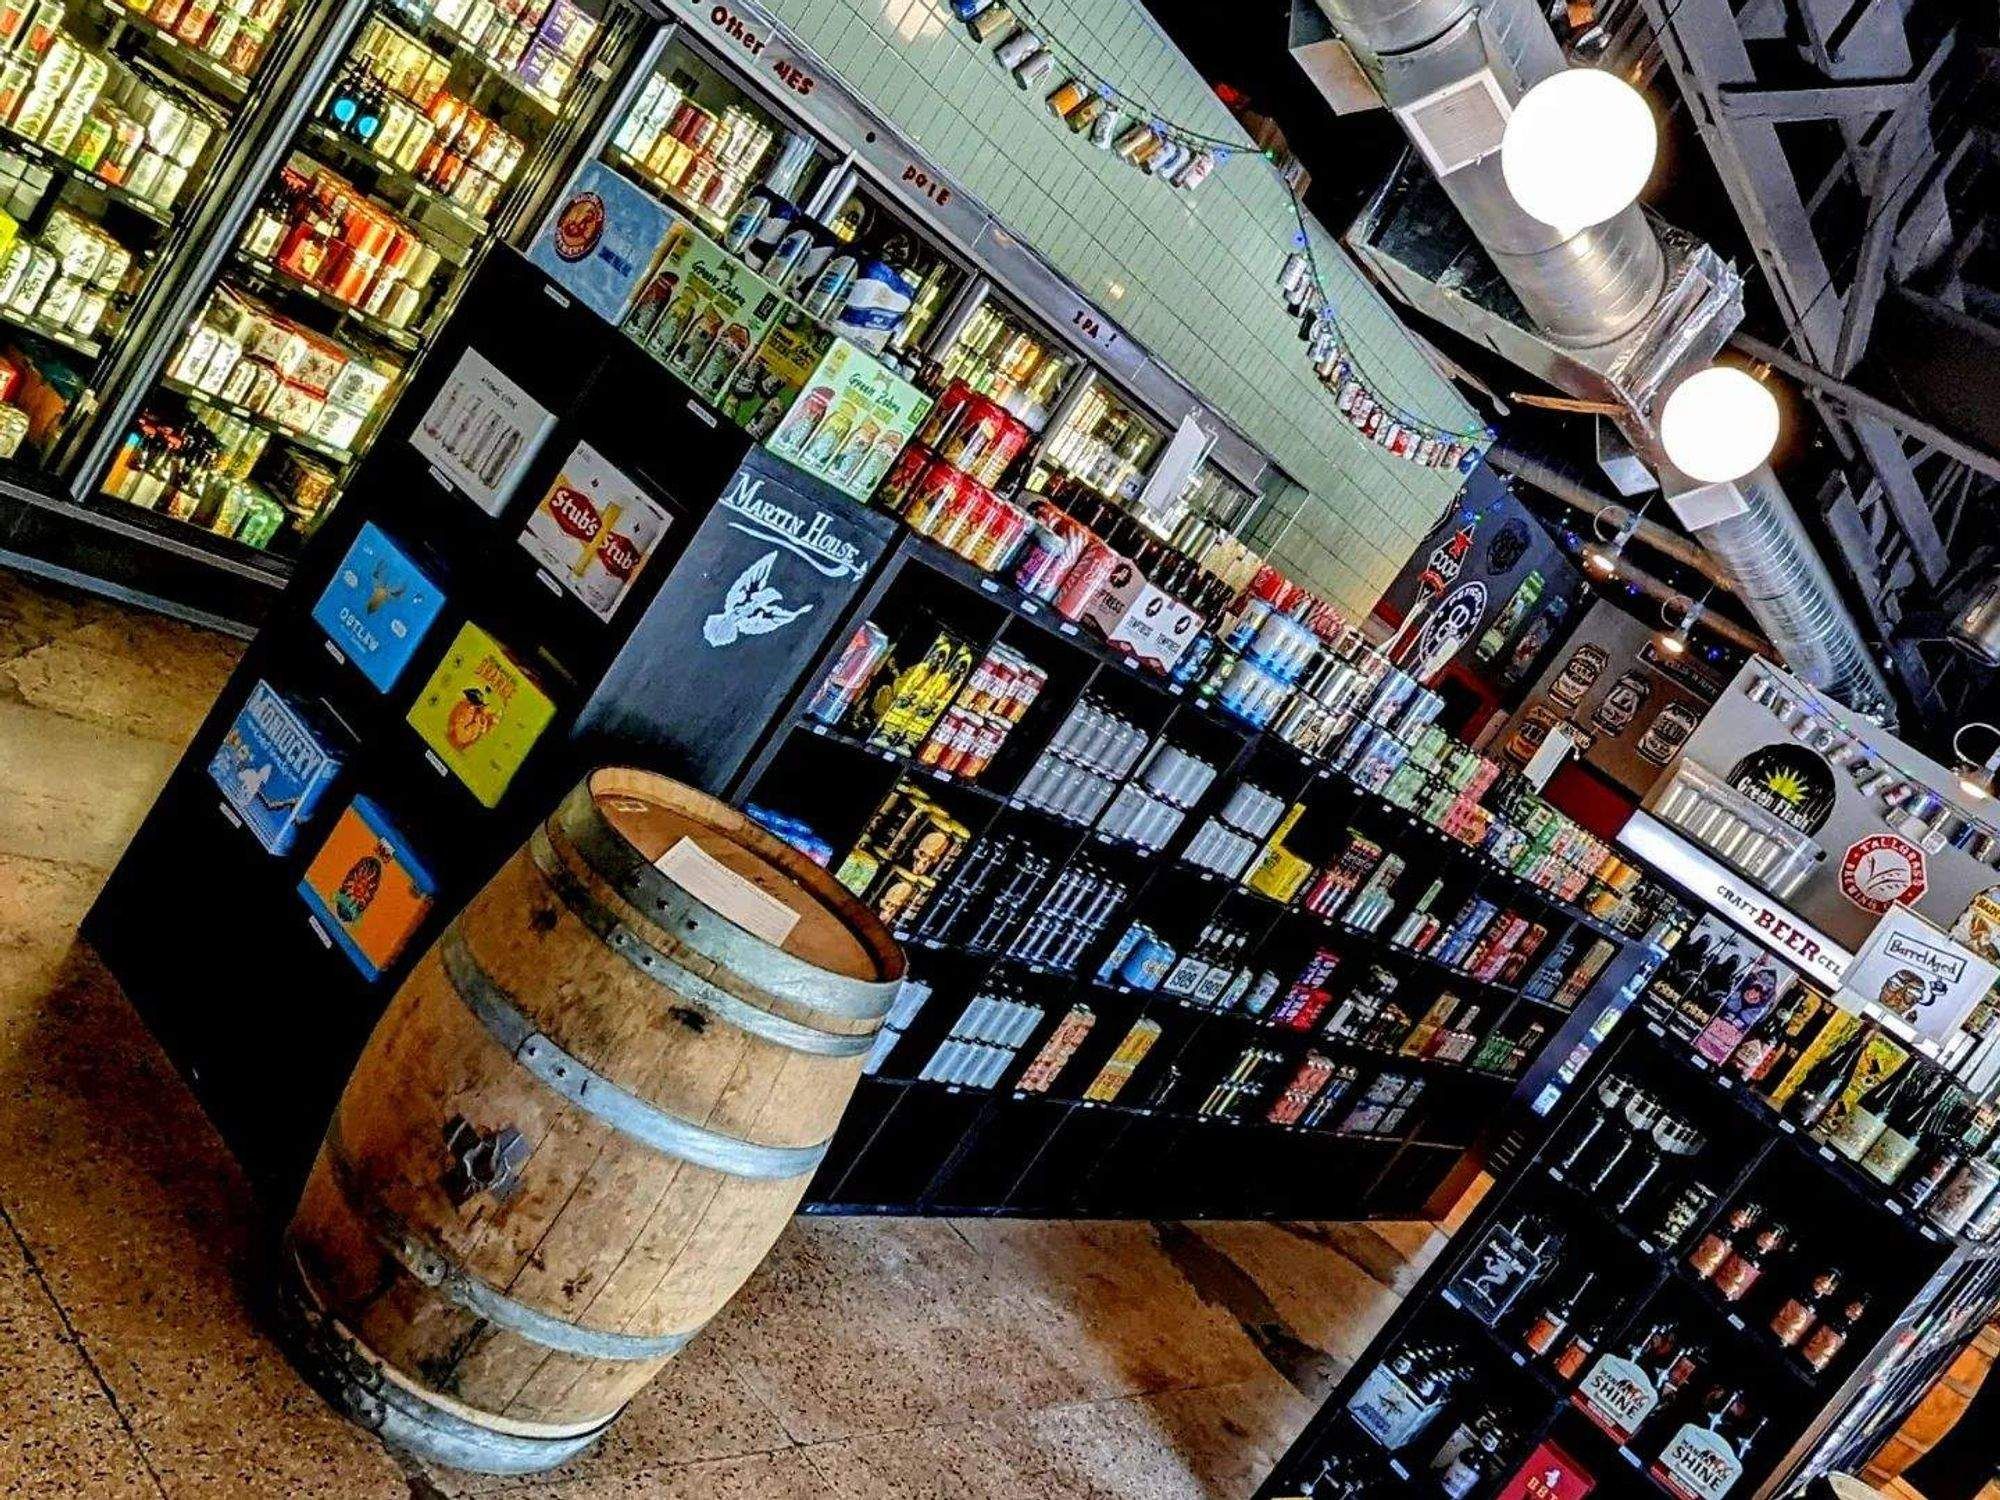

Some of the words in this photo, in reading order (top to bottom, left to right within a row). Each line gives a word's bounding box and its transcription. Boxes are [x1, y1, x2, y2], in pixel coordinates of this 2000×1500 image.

[710, 7, 764, 53] Other
[690, 258, 720, 286] Green
[1072, 309, 1098, 338] IPA
[848, 371, 876, 397] Green
[551, 490, 599, 537] Stub's
[600, 534, 639, 570] Stub'
[1737, 774, 1775, 808] Green
[1716, 884, 1758, 917] CRAFT
[1754, 908, 1822, 963] BEER
[1817, 954, 1843, 976] CEL
[1890, 939, 1929, 964] Barrel
[1922, 954, 1961, 976] Aged
[1591, 1375, 1639, 1419] SHINE
[1672, 1446, 1722, 1491] SHINE
